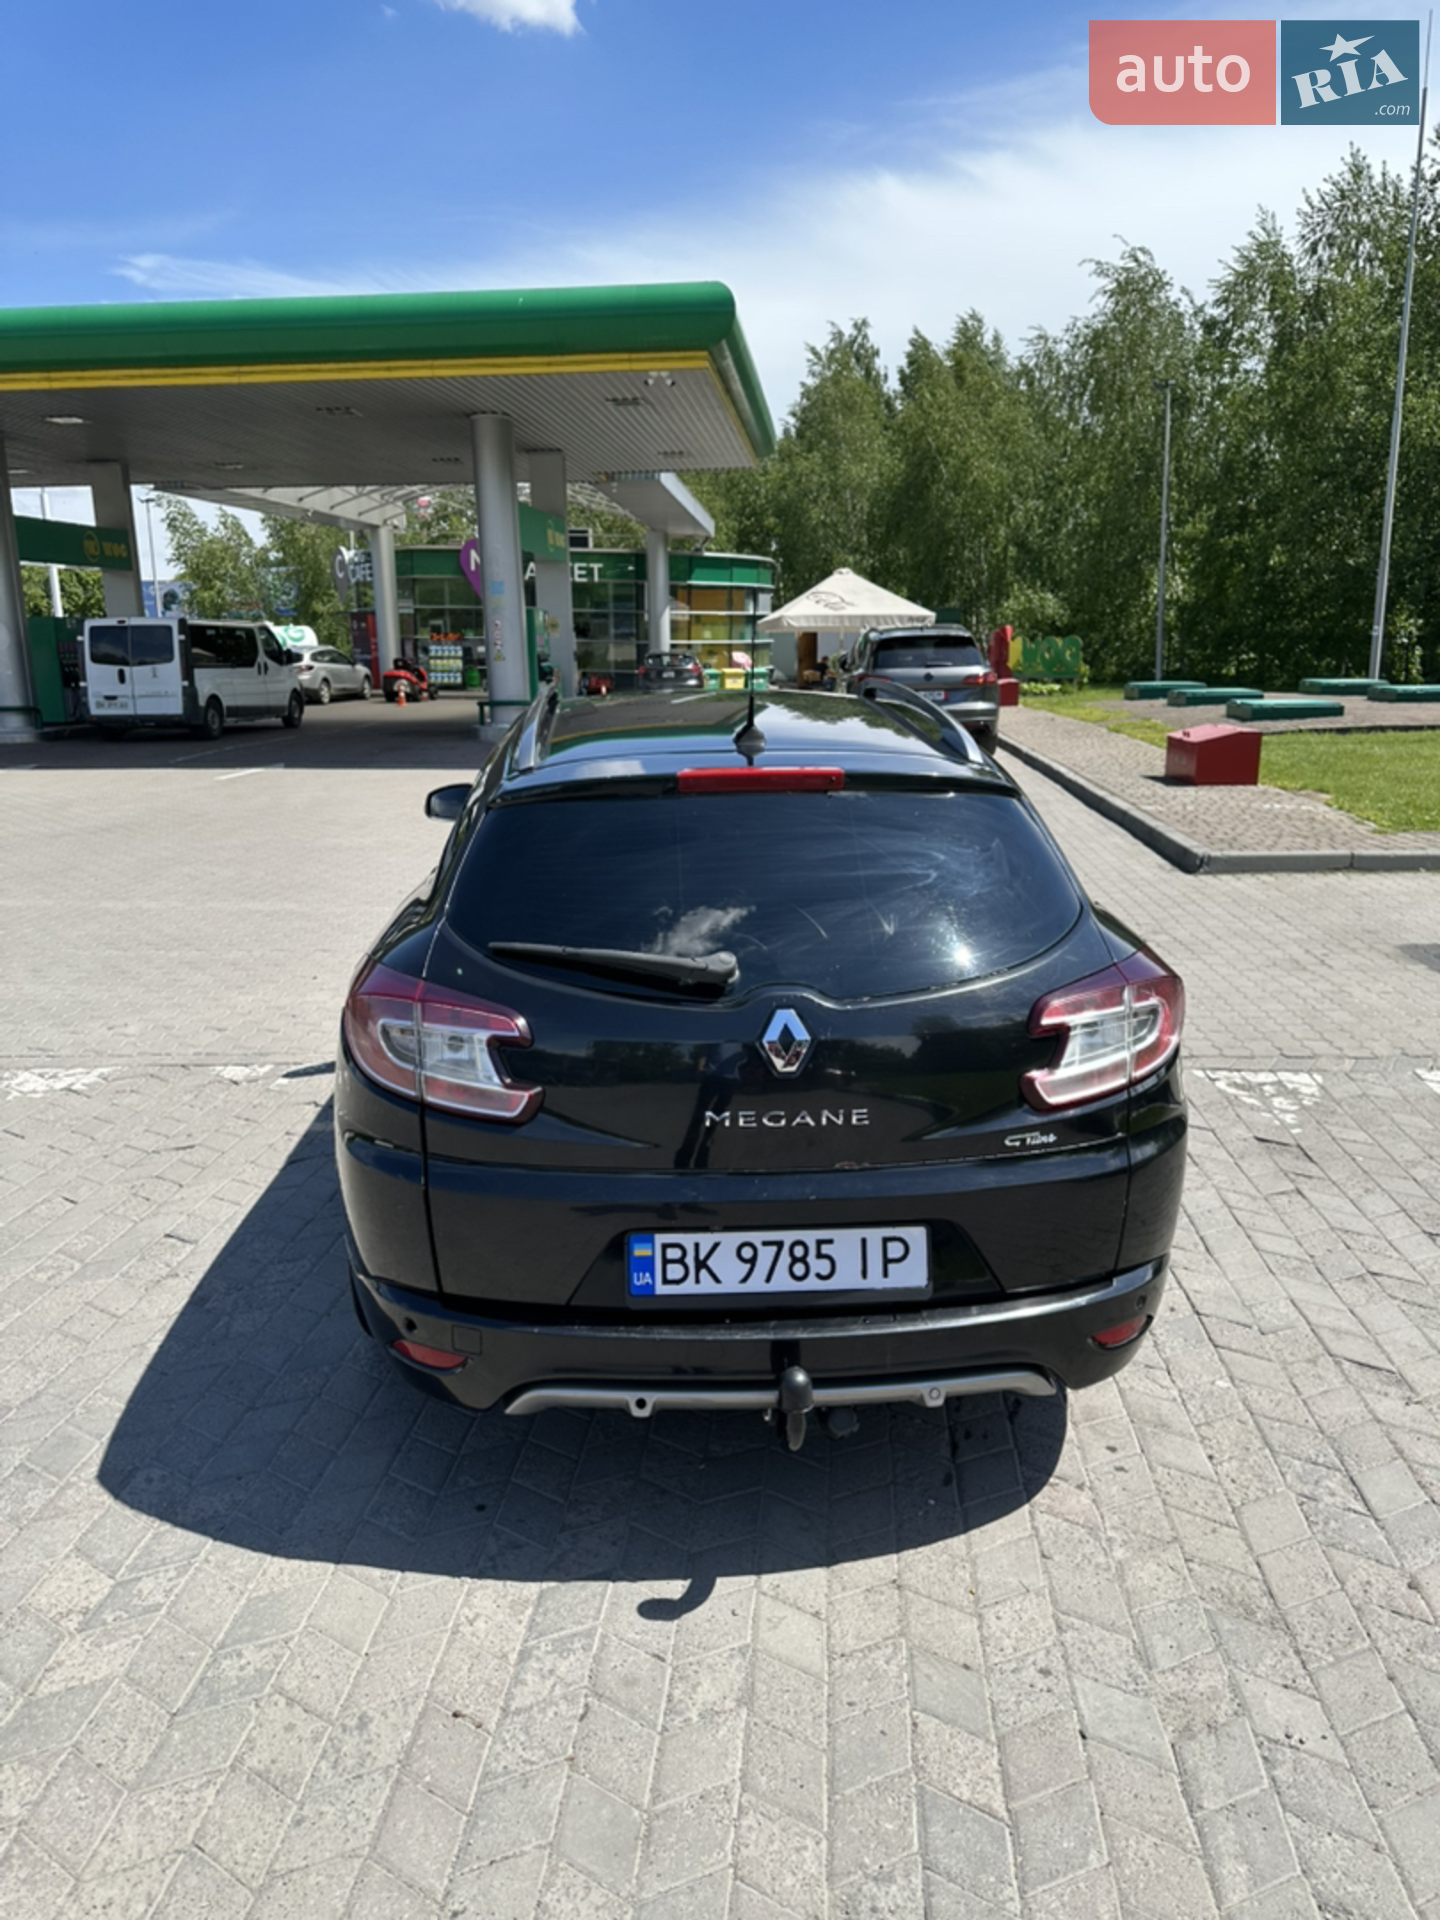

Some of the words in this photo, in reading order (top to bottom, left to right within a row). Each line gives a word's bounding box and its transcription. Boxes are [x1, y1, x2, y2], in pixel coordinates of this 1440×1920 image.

[704, 1108, 870, 1128] MEGANE
[660, 1241, 722, 1285] BK
[735, 1239, 836, 1284] 9785
[859, 1236, 911, 1281] IP
[633, 1272, 653, 1287] UA
